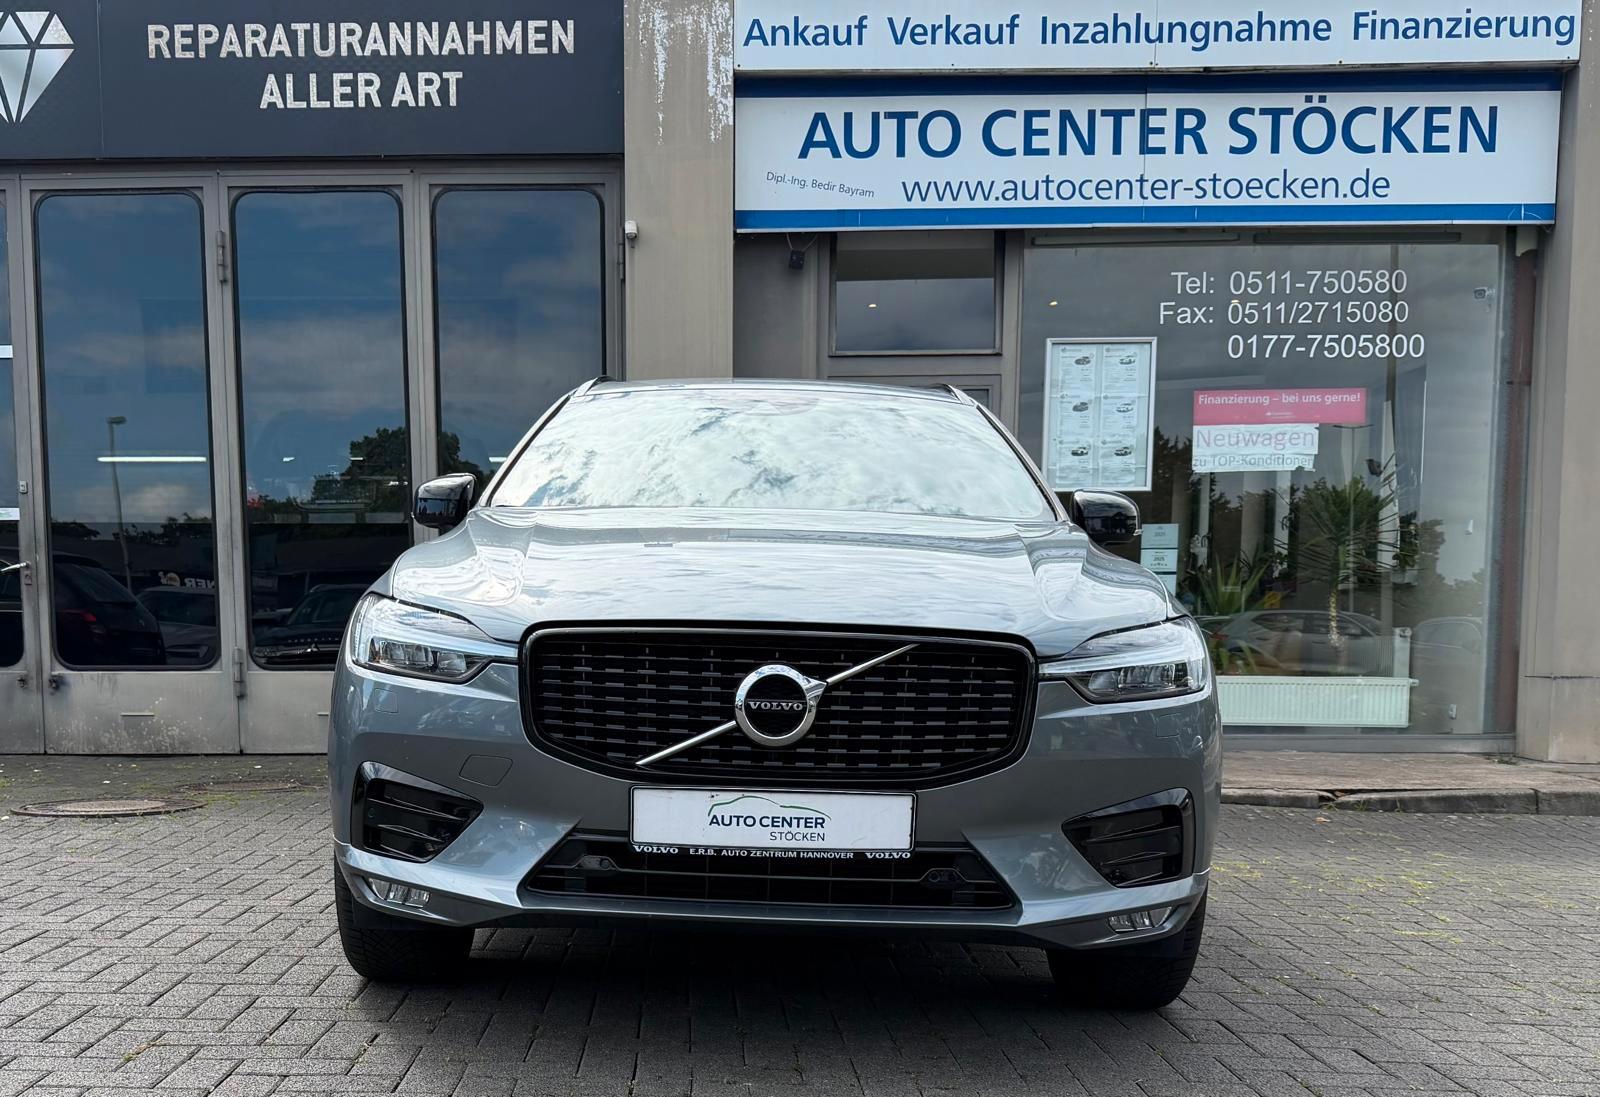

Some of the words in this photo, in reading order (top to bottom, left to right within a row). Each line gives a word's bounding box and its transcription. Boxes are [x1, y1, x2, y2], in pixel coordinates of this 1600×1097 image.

[147, 19, 575, 58] REPARATURANNAHMEN
[742, 15, 868, 47] Ankauf
[887, 14, 1020, 46] Verkauf
[1041, 11, 1332, 51] Inzahlungnahme
[1353, 8, 1575, 46] Finanzierung
[259, 72, 381, 109] ALLER
[391, 71, 463, 108] ART
[798, 109, 962, 159] AUTO
[981, 107, 1208, 157] CENTER
[1228, 94, 1499, 155] STÖCKEN
[766, 171, 808, 189] Dipl.-Ing.
[811, 178, 837, 192] Bedir
[838, 183, 875, 198] Bayram
[902, 167, 1391, 202] www.autocenter-stoecken.de
[1171, 271, 1215, 294] Tel:
[1229, 269, 1408, 295] 0511-750580
[1159, 302, 1214, 325] Fax:
[1227, 301, 1409, 324] 0511/2715080
[1227, 334, 1425, 358] 0177-7505800
[1199, 394, 1270, 406] Finanzierung
[1282, 393, 1299, 403] bei
[1302, 394, 1322, 402] uns
[1325, 392, 1361, 405] gerne!
[1196, 430, 1315, 451] Neuwagen
[1193, 458, 1207, 467] zu
[748, 701, 803, 711] VOLVO
[709, 814, 756, 828] AUTO
[758, 815, 826, 829] CENTER
[769, 831, 826, 842] STÖCKEN
[633, 845, 679, 854] VOLVO
[689, 848, 717, 856] E.R.B.
[721, 849, 748, 857] AUTO
[750, 850, 797, 858] ZENTRUM
[800, 851, 854, 859] HANNOVER
[865, 852, 911, 860] VOLVO
